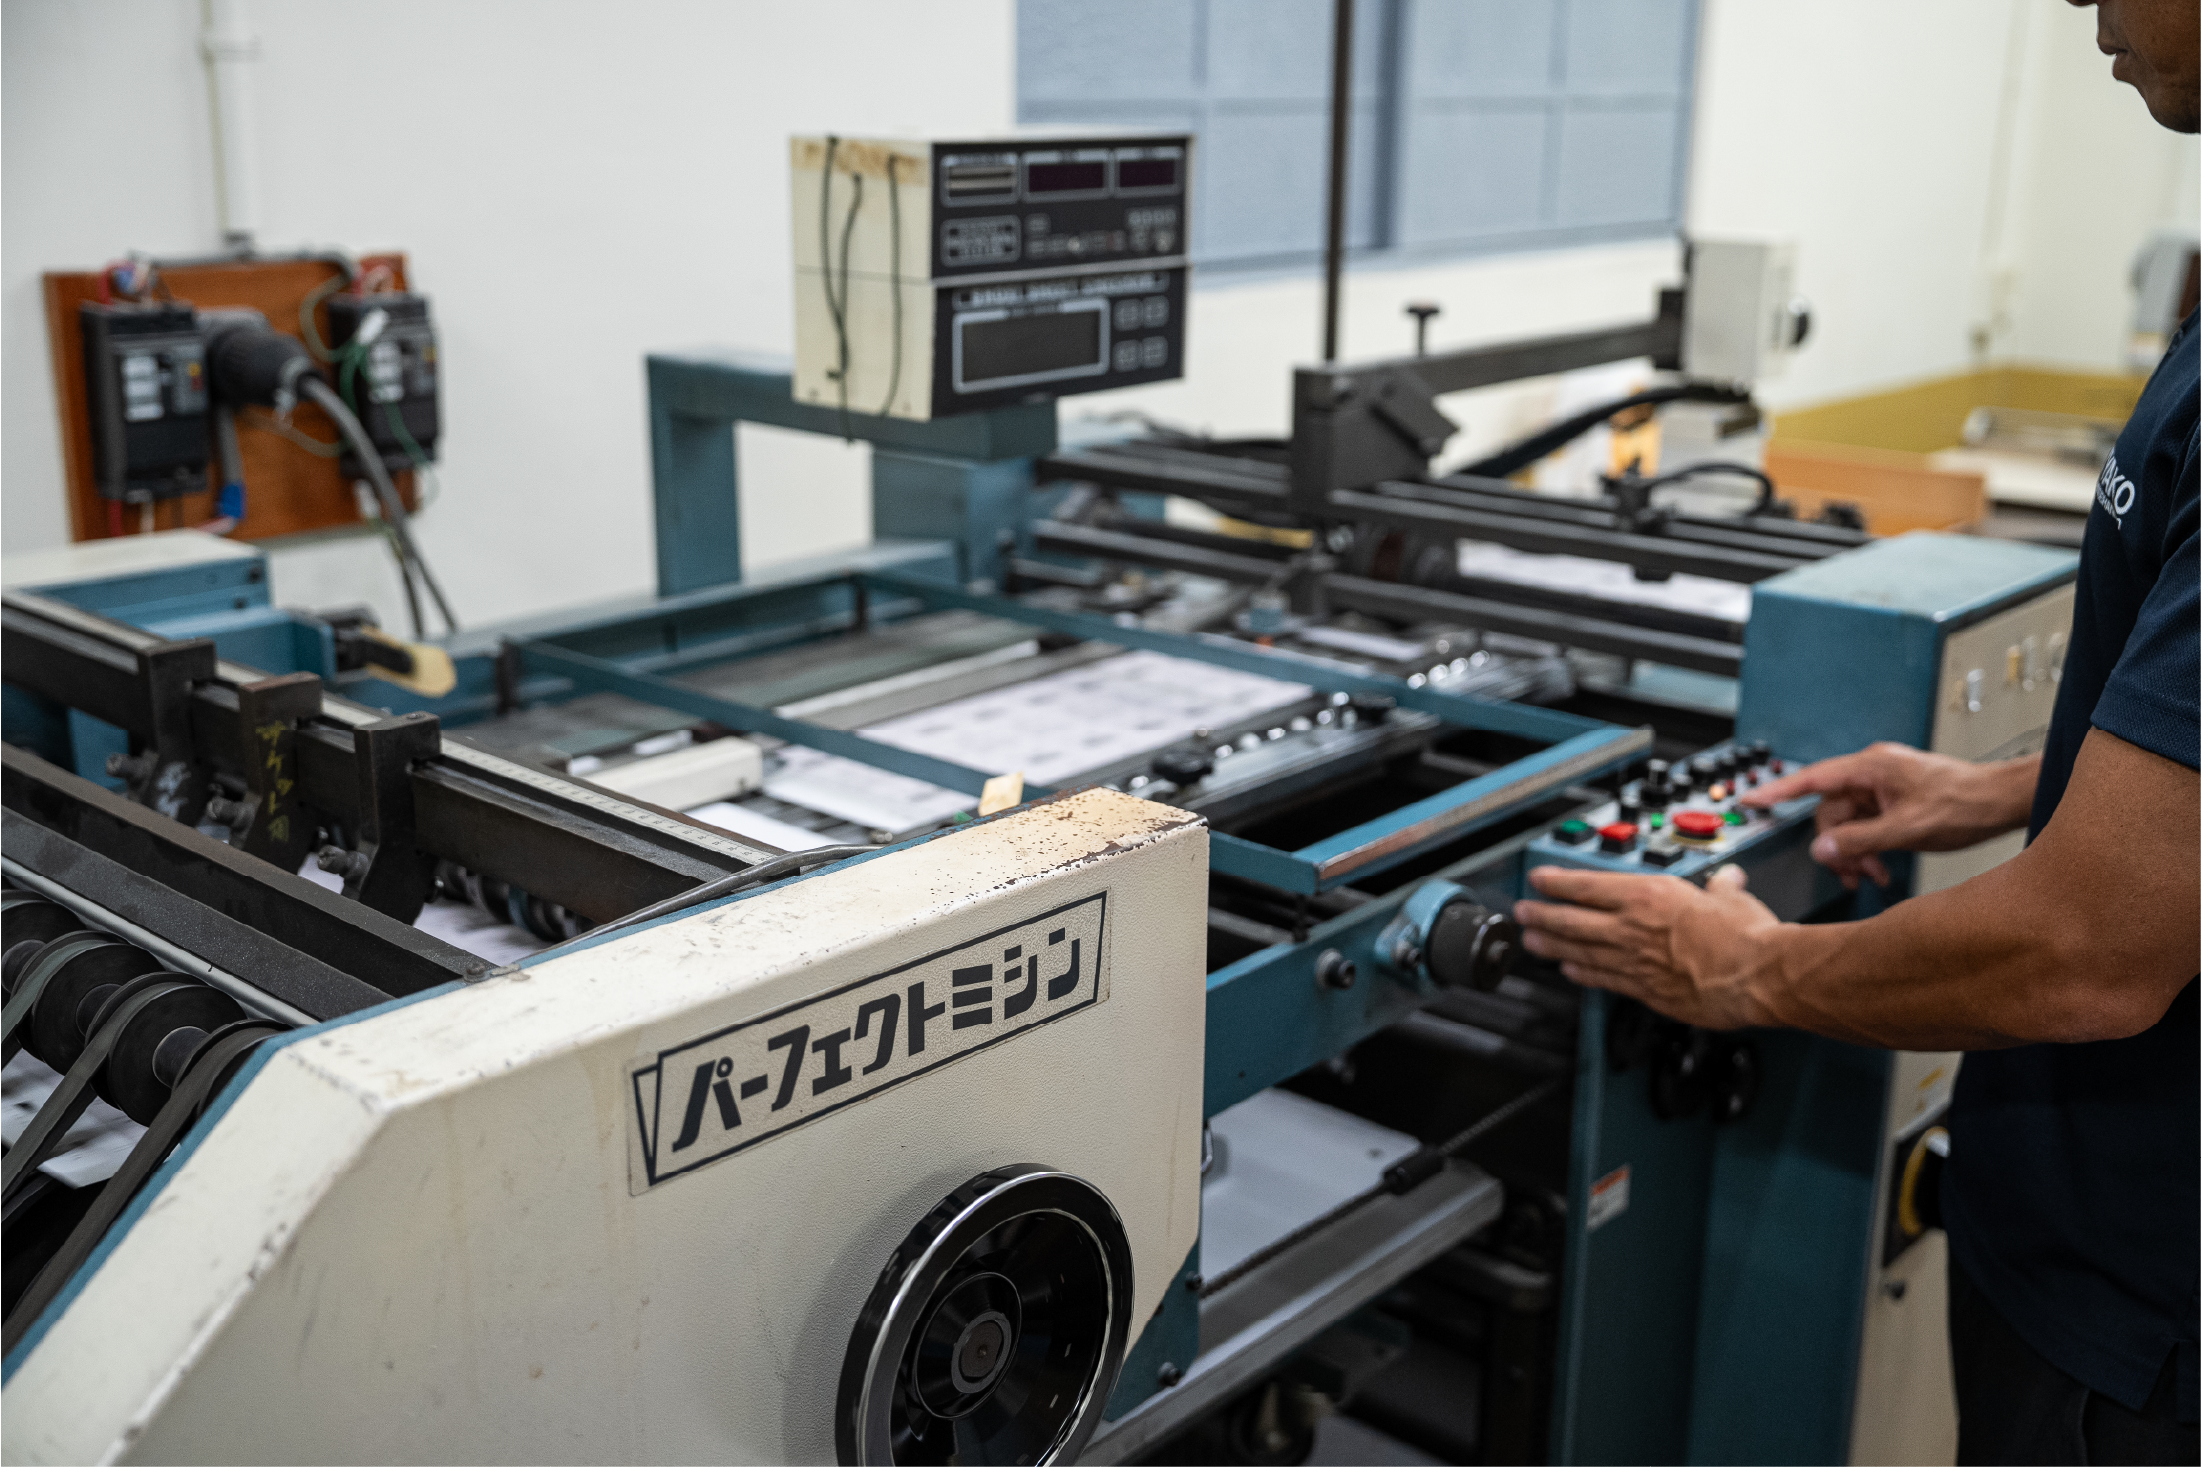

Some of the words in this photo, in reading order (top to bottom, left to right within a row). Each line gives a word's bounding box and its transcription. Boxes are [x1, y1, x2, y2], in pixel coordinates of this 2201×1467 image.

[672, 927, 1080, 1152] パーフェクトミシン
